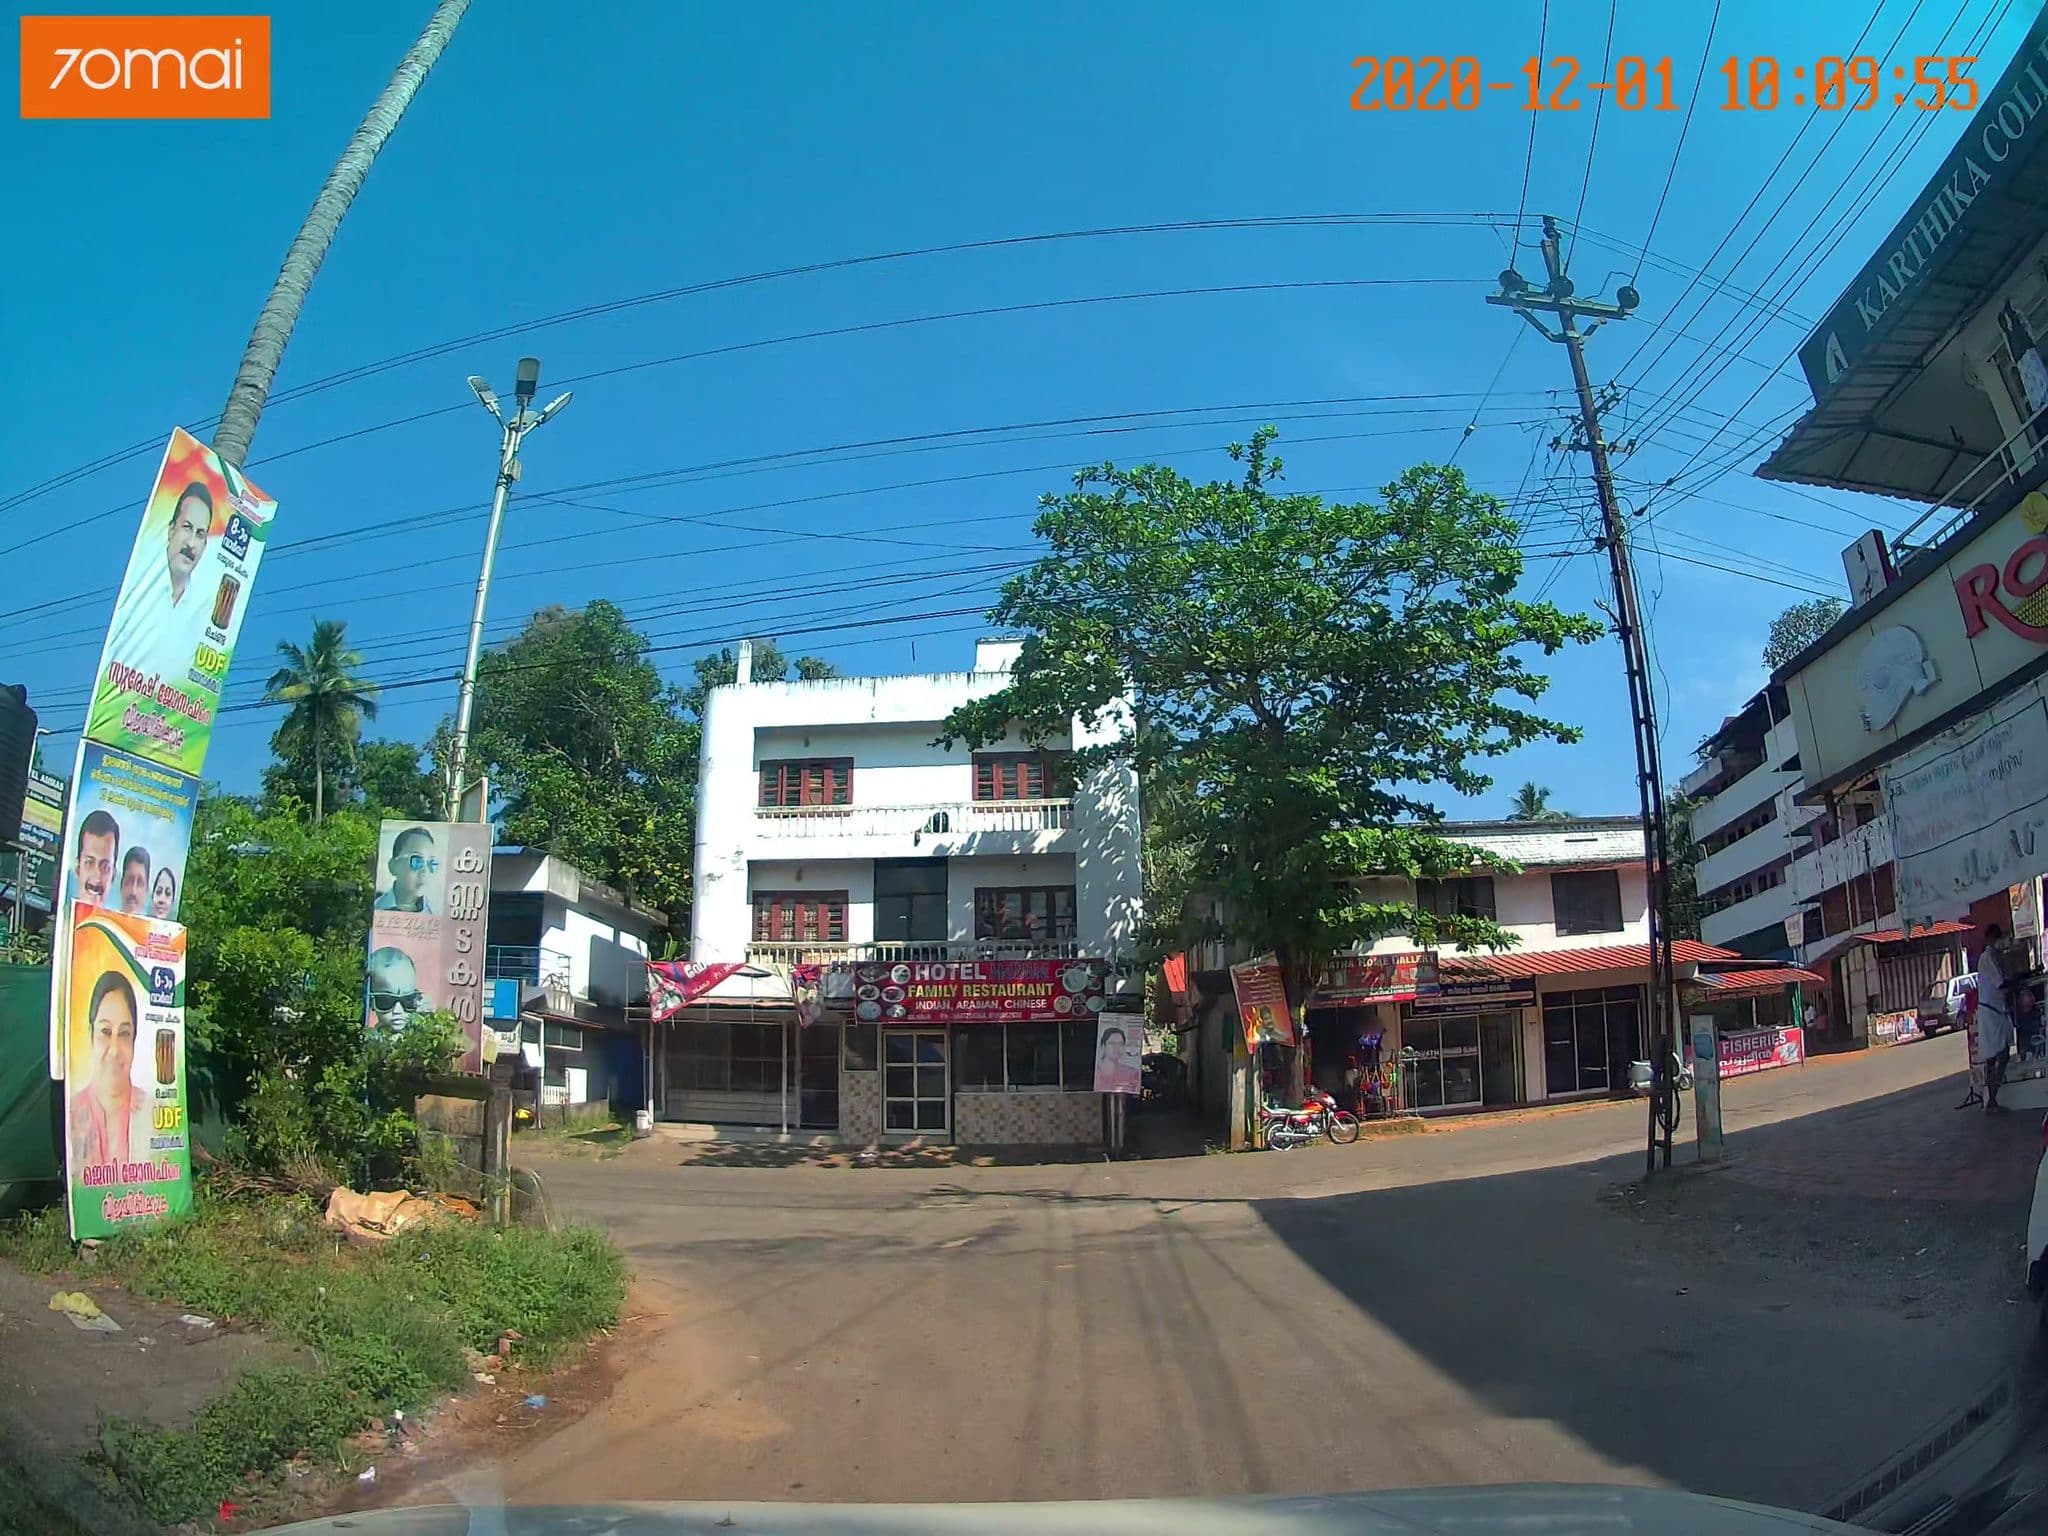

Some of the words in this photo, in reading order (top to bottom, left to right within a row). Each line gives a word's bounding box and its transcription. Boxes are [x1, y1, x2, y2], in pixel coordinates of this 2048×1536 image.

[1855, 156, 1992, 333] KARTHIKA
[196, 643, 227, 676] UDF
[915, 963, 987, 981] HOTEL
[908, 983, 958, 999] FAMILY
[963, 982, 1055, 998] RESTAURANT
[1004, 998, 1048, 1009] CHINESE
[1721, 1031, 1788, 1056] FISHERIES
[153, 1105, 183, 1130] UDF
